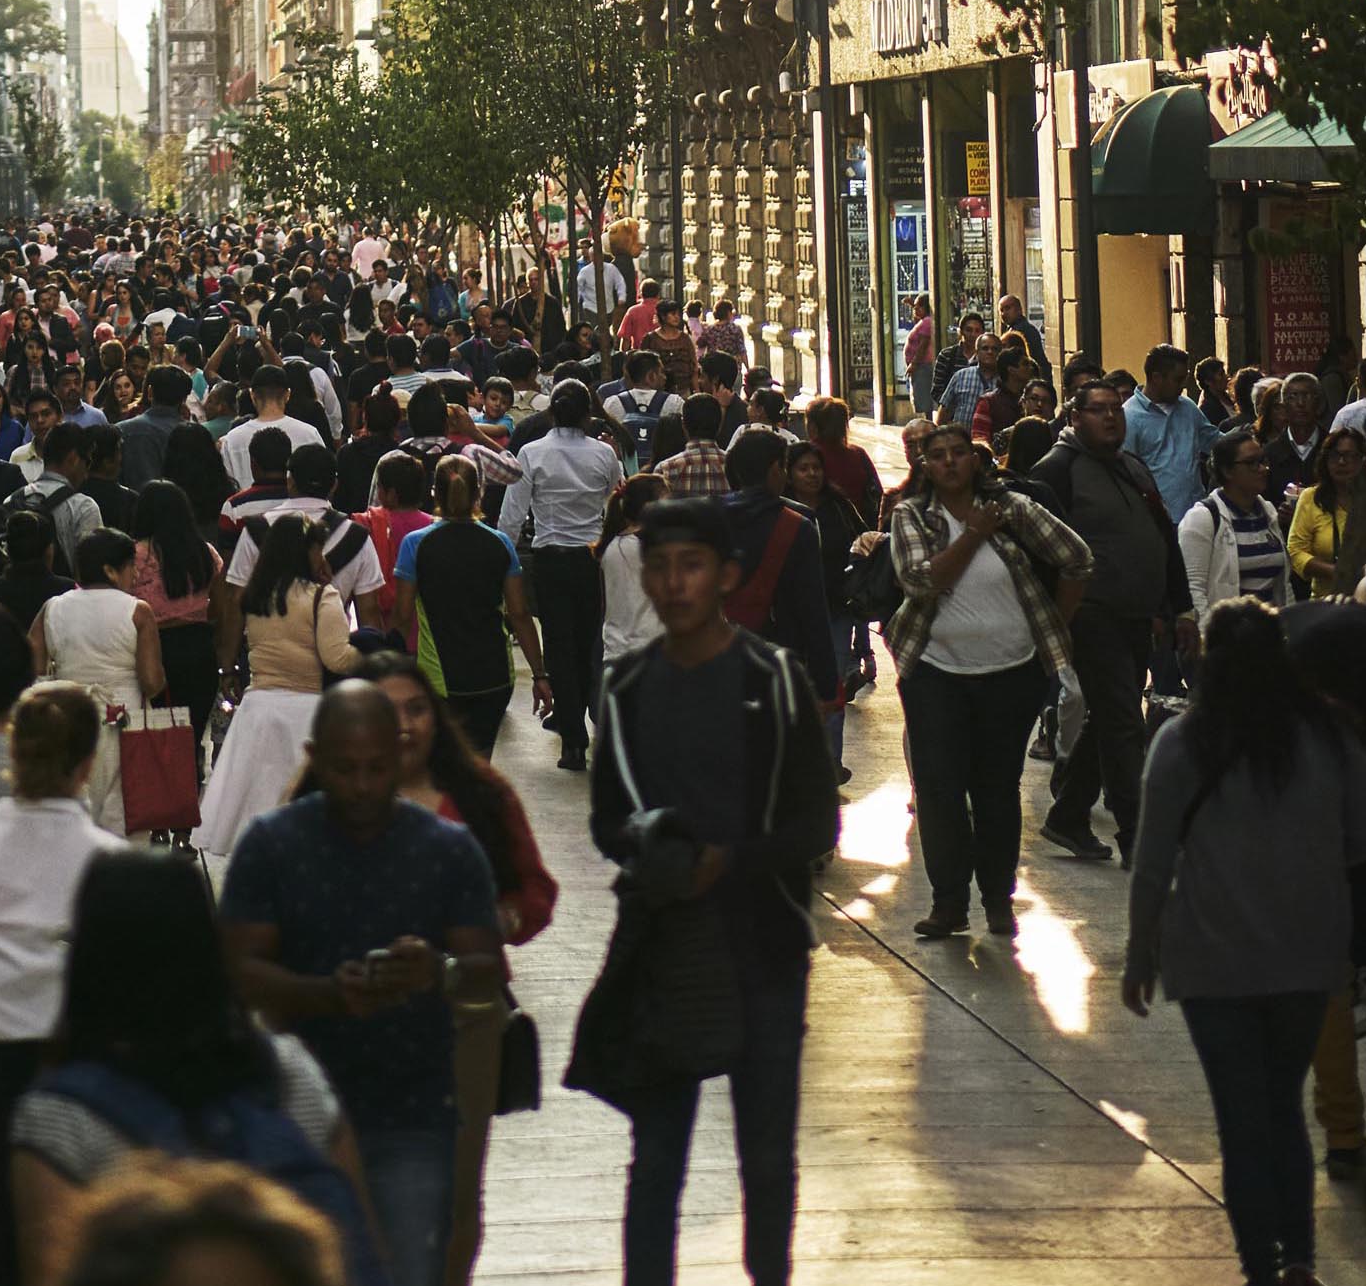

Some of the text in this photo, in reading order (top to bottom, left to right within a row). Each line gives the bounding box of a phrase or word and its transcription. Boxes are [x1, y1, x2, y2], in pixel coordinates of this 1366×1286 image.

[1270, 275, 1330, 285] PIZZA DE
[1274, 312, 1329, 321] LOMO
